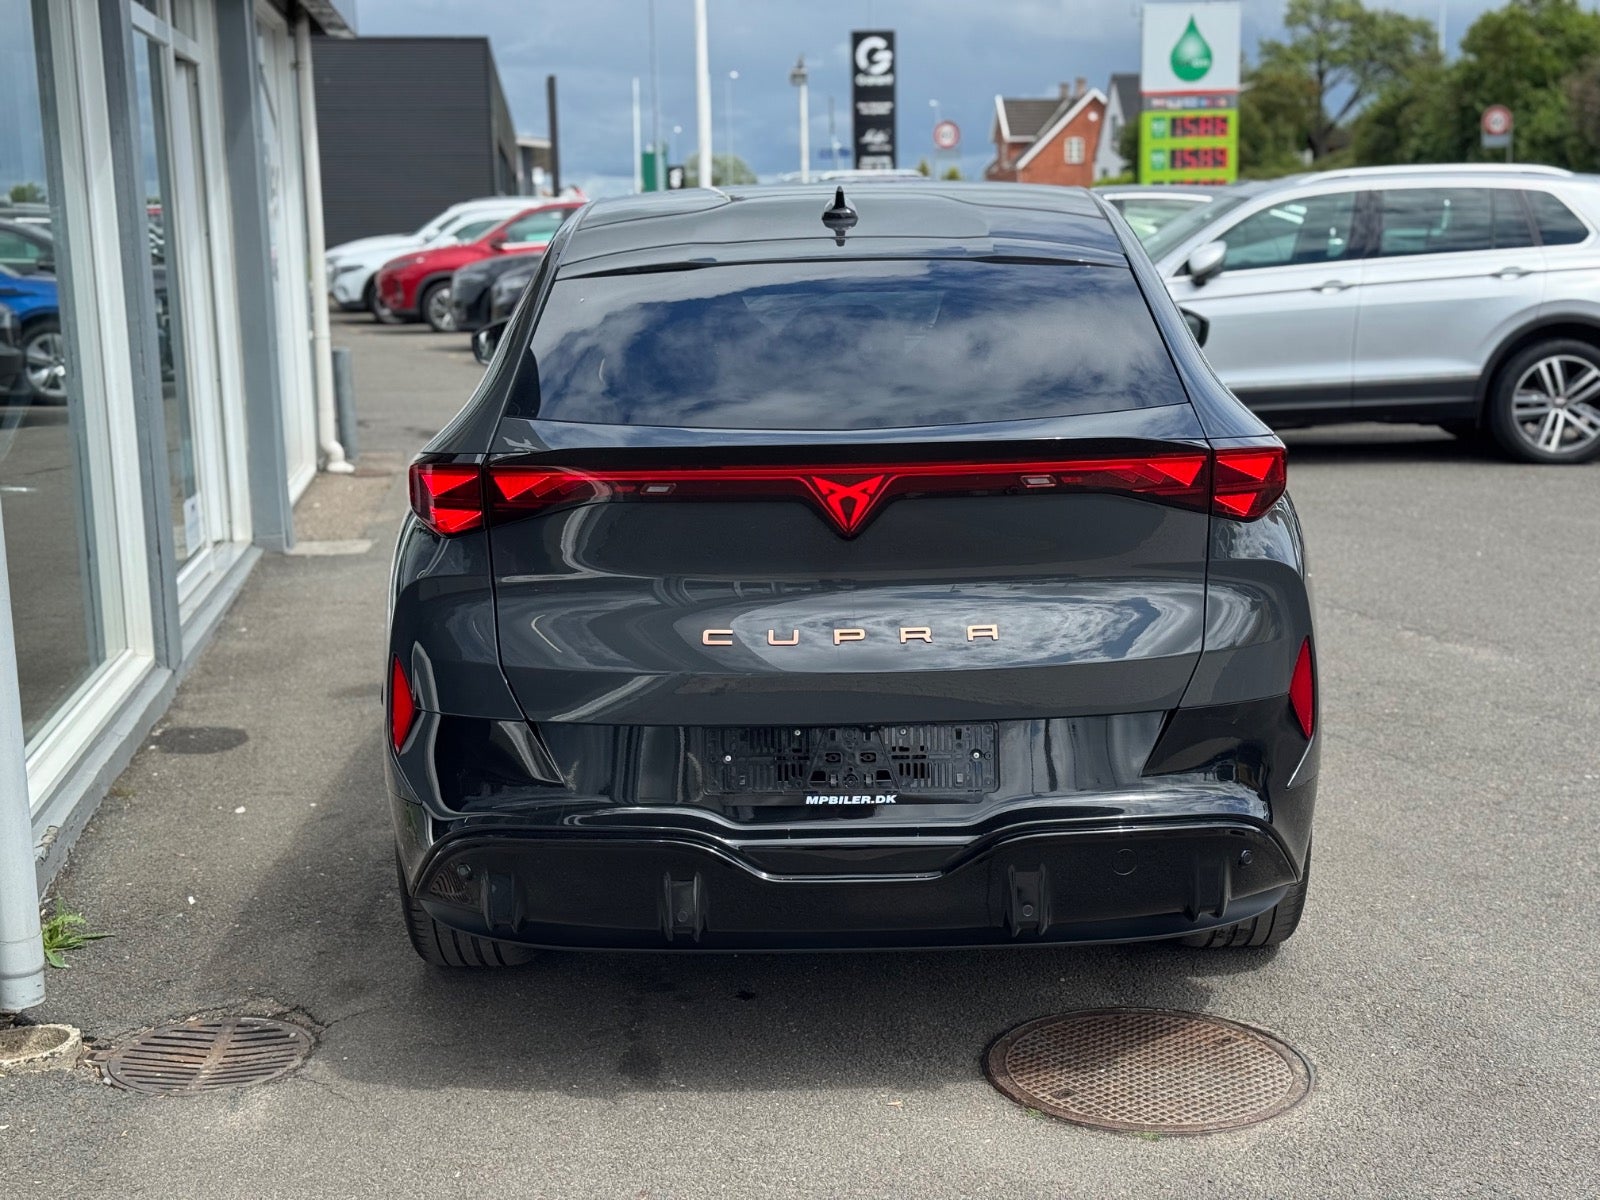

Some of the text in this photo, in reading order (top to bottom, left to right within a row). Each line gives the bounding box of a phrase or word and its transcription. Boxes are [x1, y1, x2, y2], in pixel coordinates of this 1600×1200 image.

[855, 35, 893, 75] G
[702, 623, 999, 646] CUPRA
[805, 794, 897, 805] MPBILER.DK
